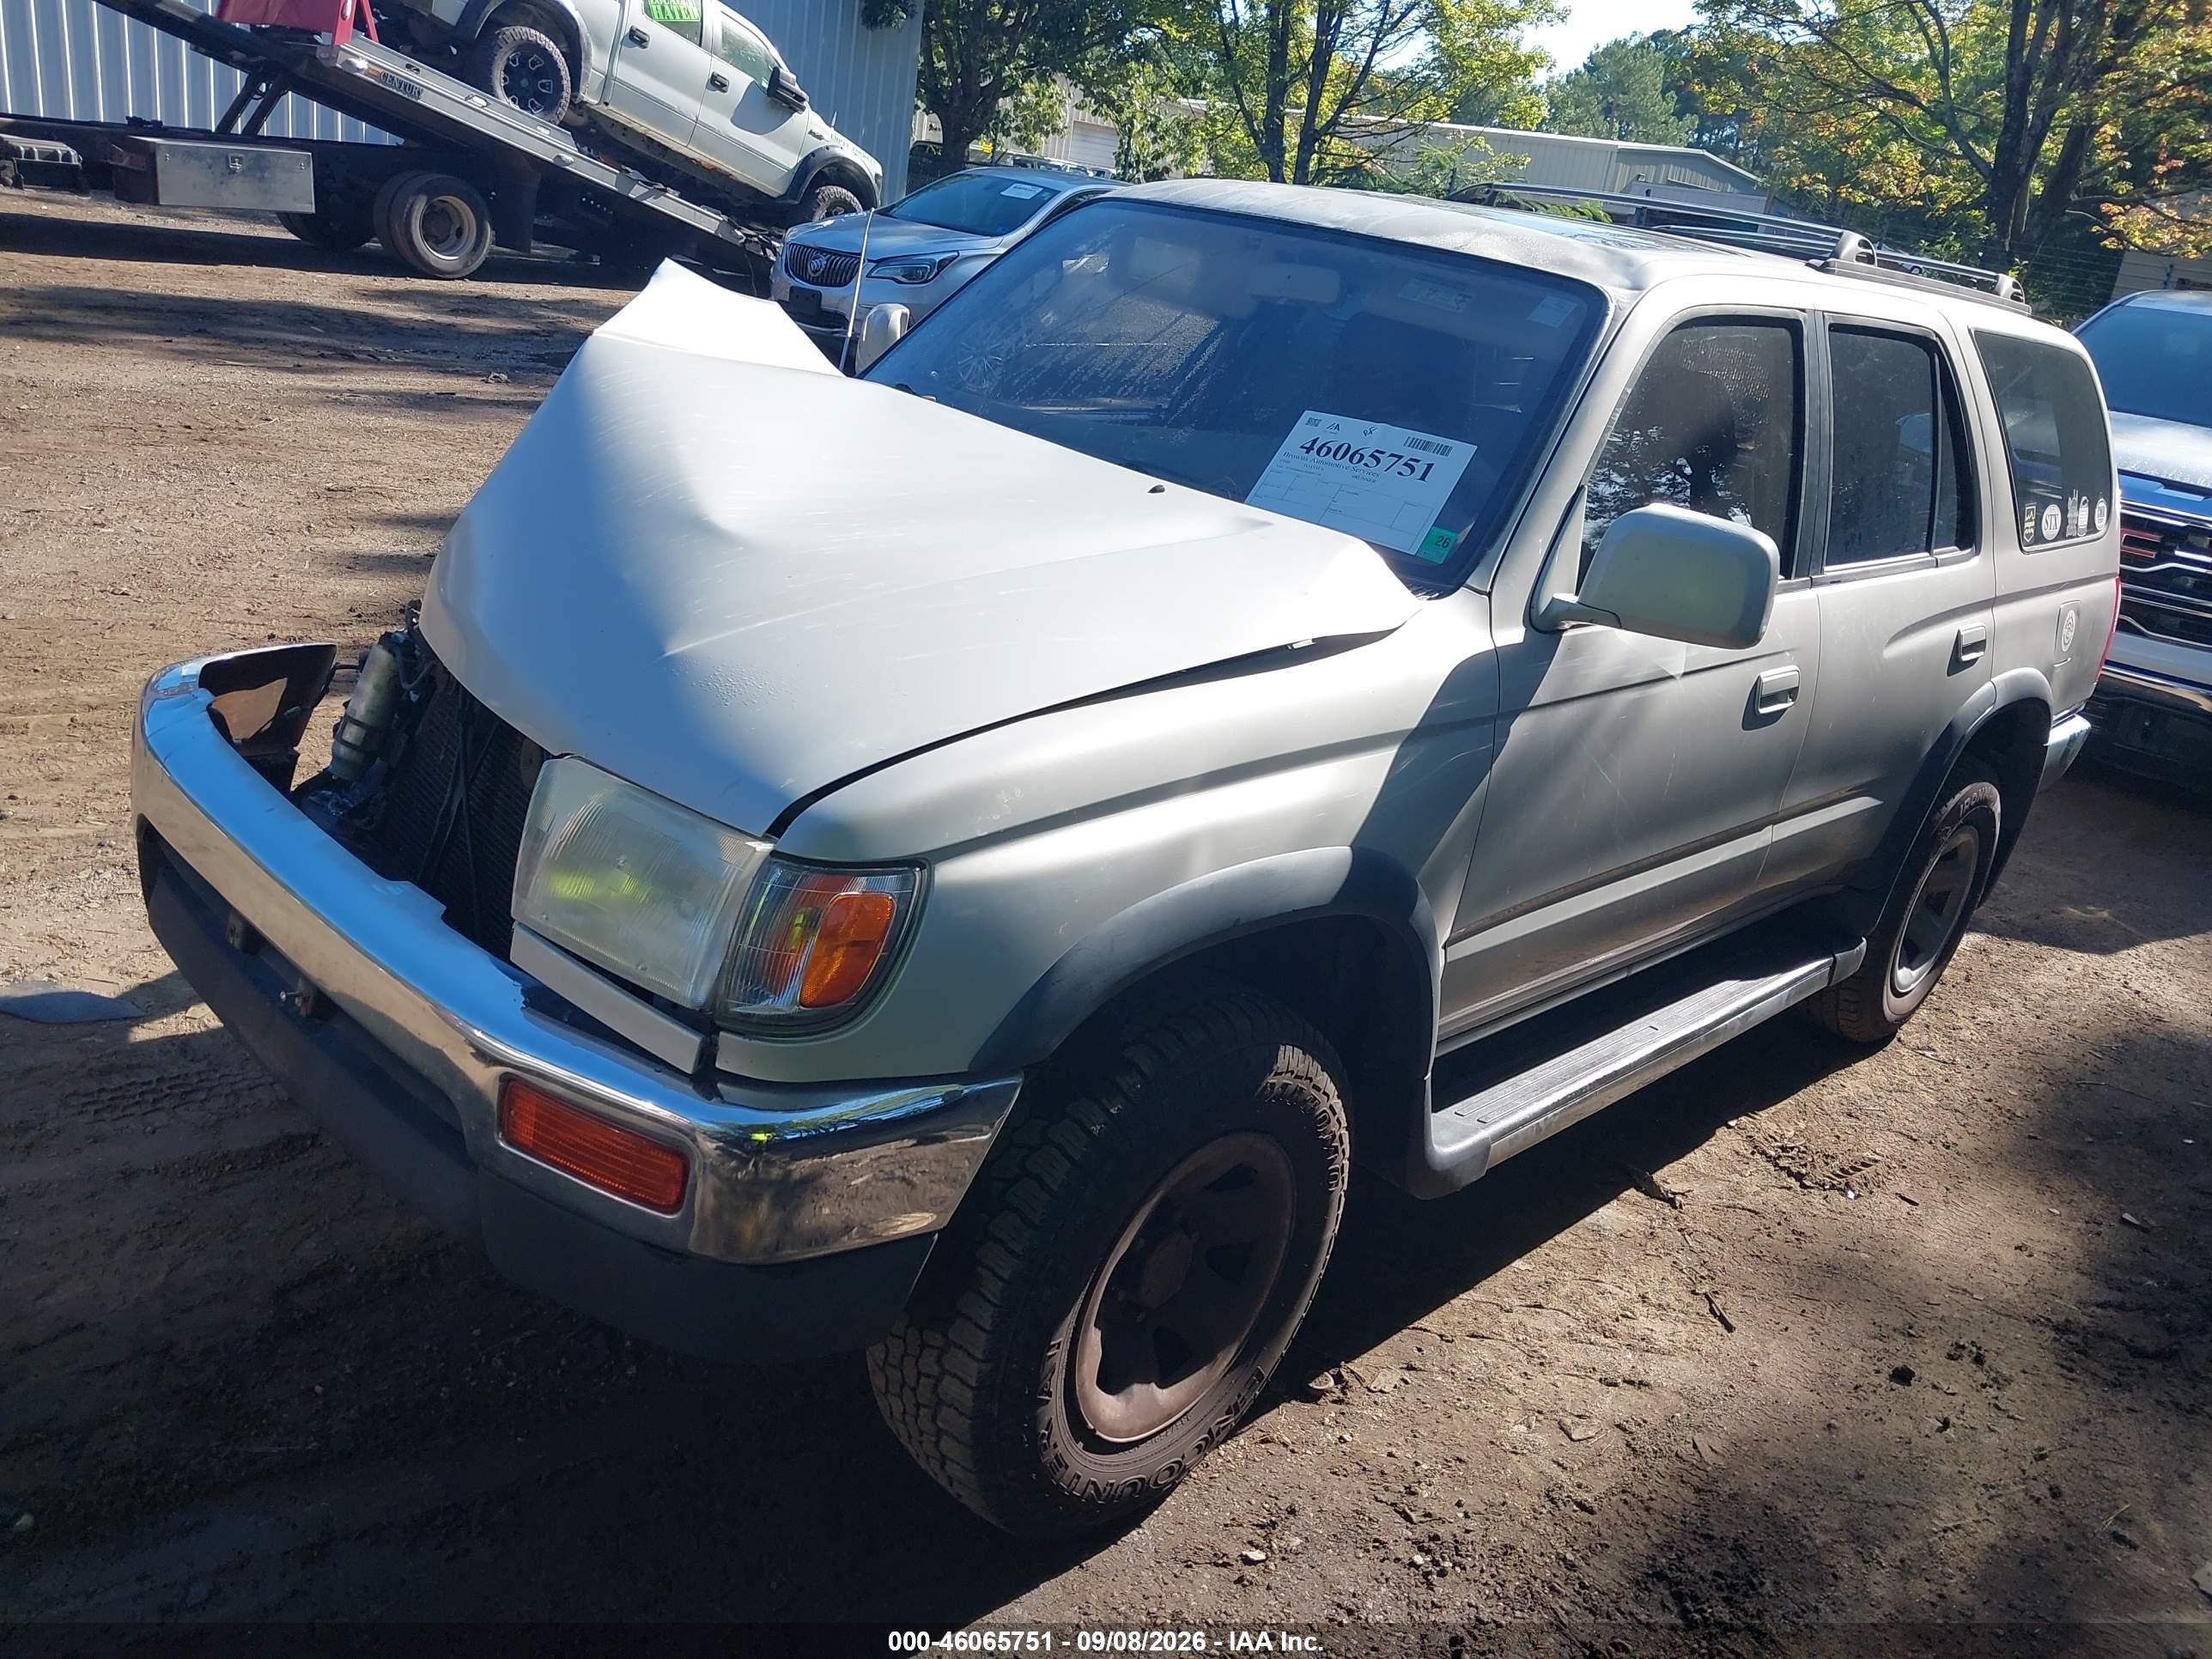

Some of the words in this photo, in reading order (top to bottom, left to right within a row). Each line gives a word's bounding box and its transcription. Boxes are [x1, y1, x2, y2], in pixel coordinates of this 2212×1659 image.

[380, 70, 424, 100] CENTURY
[1298, 436, 1436, 483] 46065751
[1311, 457, 1351, 471] Automotive
[1351, 465, 1381, 479] Services
[1434, 535, 1451, 549] 26
